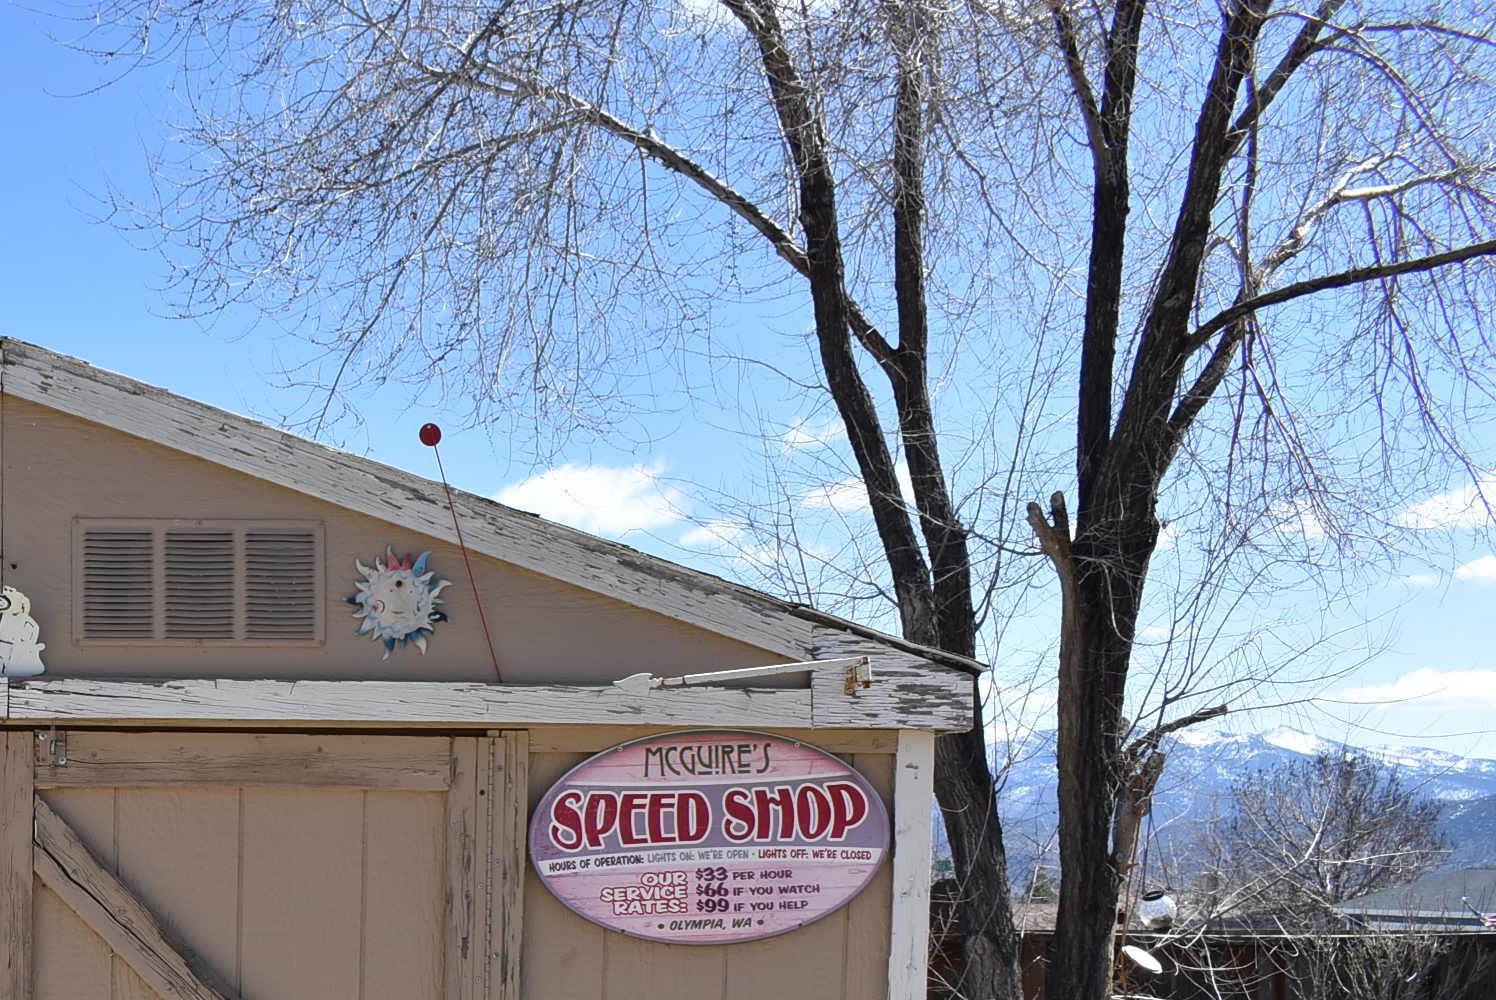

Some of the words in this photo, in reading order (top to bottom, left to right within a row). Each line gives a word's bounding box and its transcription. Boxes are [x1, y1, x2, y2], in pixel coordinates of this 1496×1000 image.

[549, 790, 712, 852] SPEED
[722, 782, 868, 844] SHOP
[549, 860, 577, 872] HOURS
[579, 858, 591, 869] OF
[594, 854, 644, 868] OPERATION:
[647, 852, 677, 863] LIGHTS
[698, 849, 723, 860] WE'RE
[726, 849, 750, 860] OPEN
[758, 848, 788, 859] LIGHTS
[812, 849, 837, 860] WE'RE
[840, 850, 872, 861] CLOSED
[641, 871, 688, 887] OUR
[695, 866, 729, 882] $33
[732, 871, 755, 881] PER
[759, 869, 793, 880] HOUR
[600, 885, 688, 902] SERVICE
[695, 882, 729, 898] $66
[733, 887, 744, 897] IF
[749, 886, 773, 896] YOU
[778, 883, 821, 894] WATCH
[613, 900, 688, 915] RATES:
[695, 897, 730, 913] $99
[734, 902, 745, 912] IF
[750, 901, 774, 911] YOU
[778, 900, 809, 911] HELP
[669, 917, 727, 932] OLYMPIA,
[732, 918, 752, 929] WA
